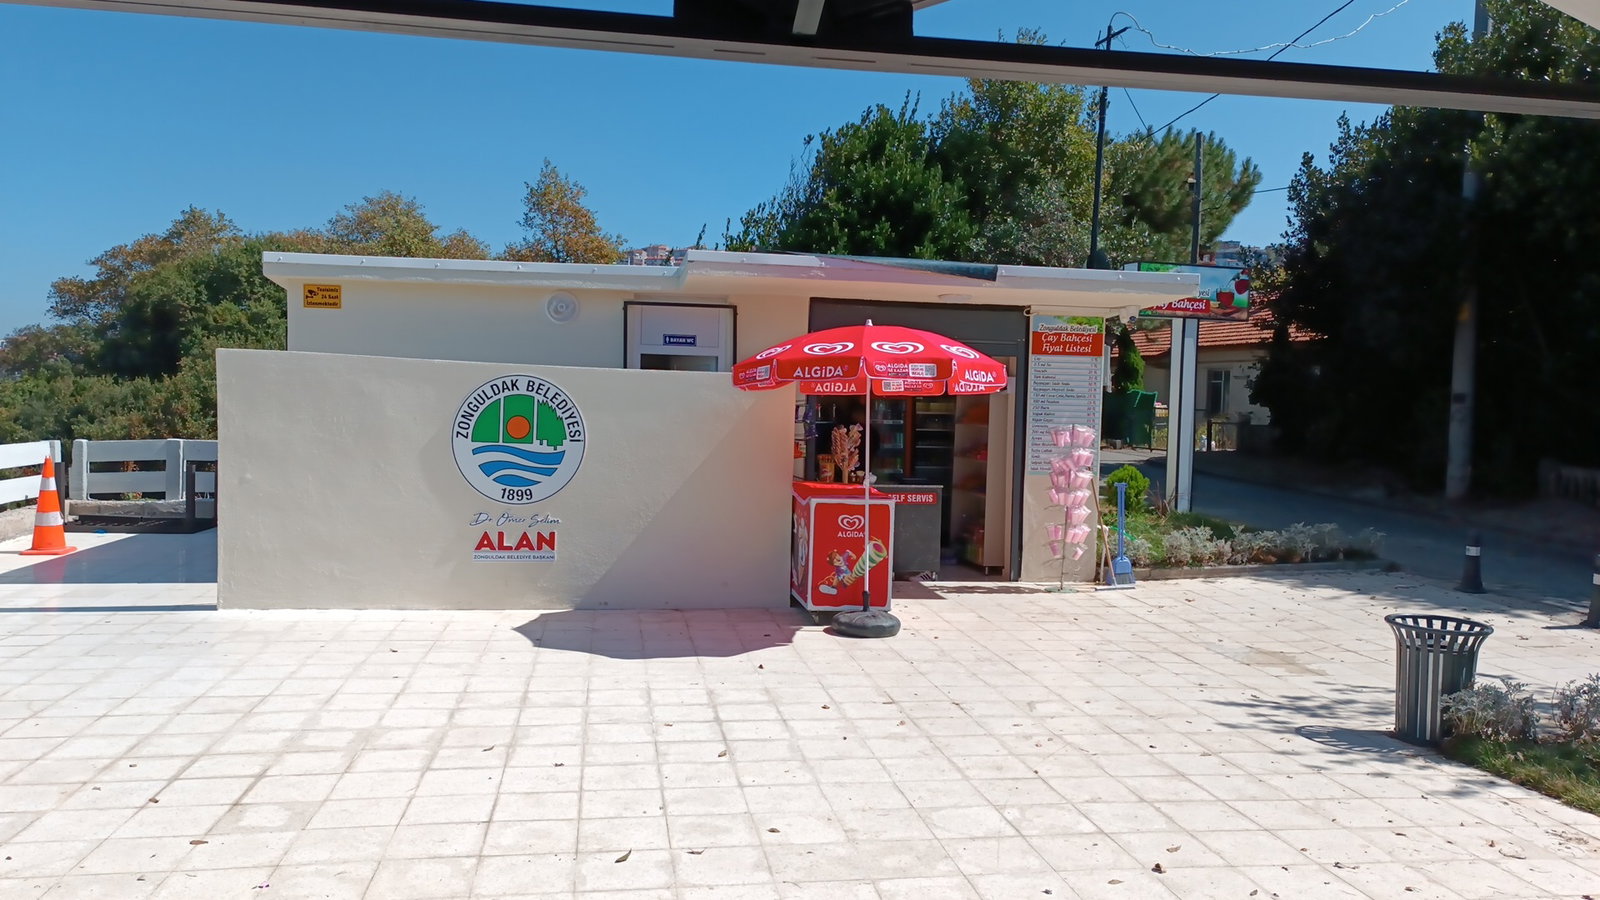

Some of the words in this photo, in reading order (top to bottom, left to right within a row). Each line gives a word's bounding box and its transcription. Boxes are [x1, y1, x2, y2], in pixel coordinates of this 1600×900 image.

[1172, 299, 1206, 310] Bahçesi
[1039, 323, 1069, 333] Zonguldak
[1041, 332, 1059, 344] Çay
[1060, 333, 1093, 344] Bahçesi
[1042, 343, 1064, 354] Fiyat
[1065, 344, 1092, 353] Listesi
[456, 378, 520, 440] ZONGULDAK
[526, 379, 584, 443] BELEDİYESİ
[501, 487, 533, 501] 1899
[475, 531, 555, 550] ALAN
